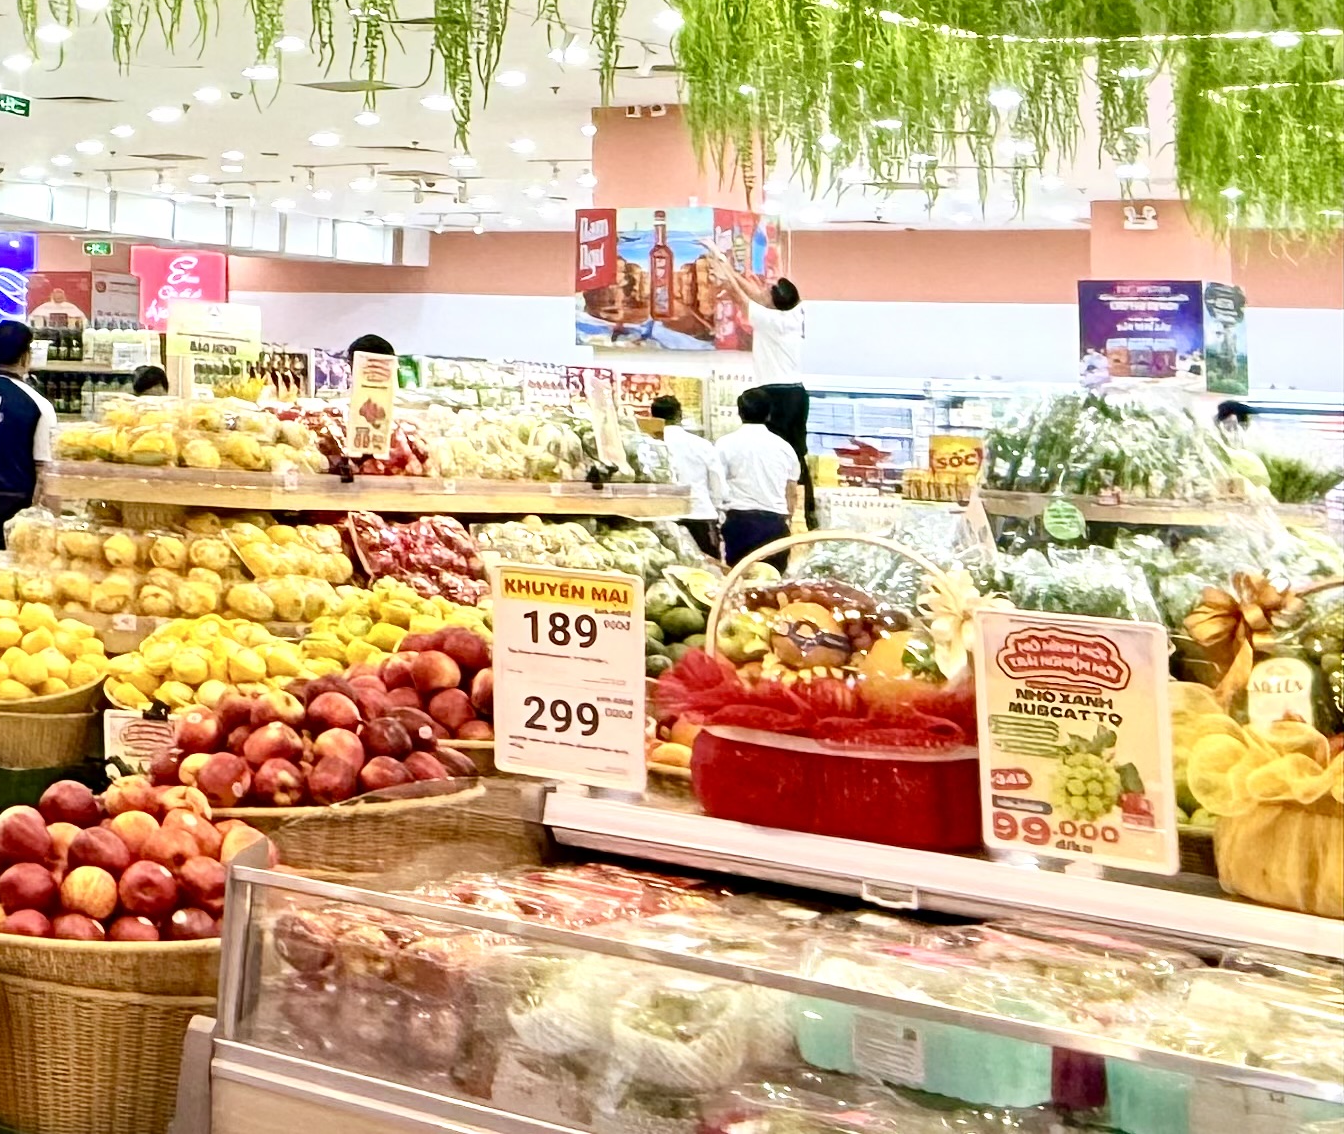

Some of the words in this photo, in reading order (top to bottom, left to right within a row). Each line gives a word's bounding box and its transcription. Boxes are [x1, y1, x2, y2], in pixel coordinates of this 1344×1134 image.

[936, 449, 978, 470] SỐC
[523, 610, 598, 648] 189
[523, 695, 600, 737] 299
[993, 811, 1120, 846] 99.000
